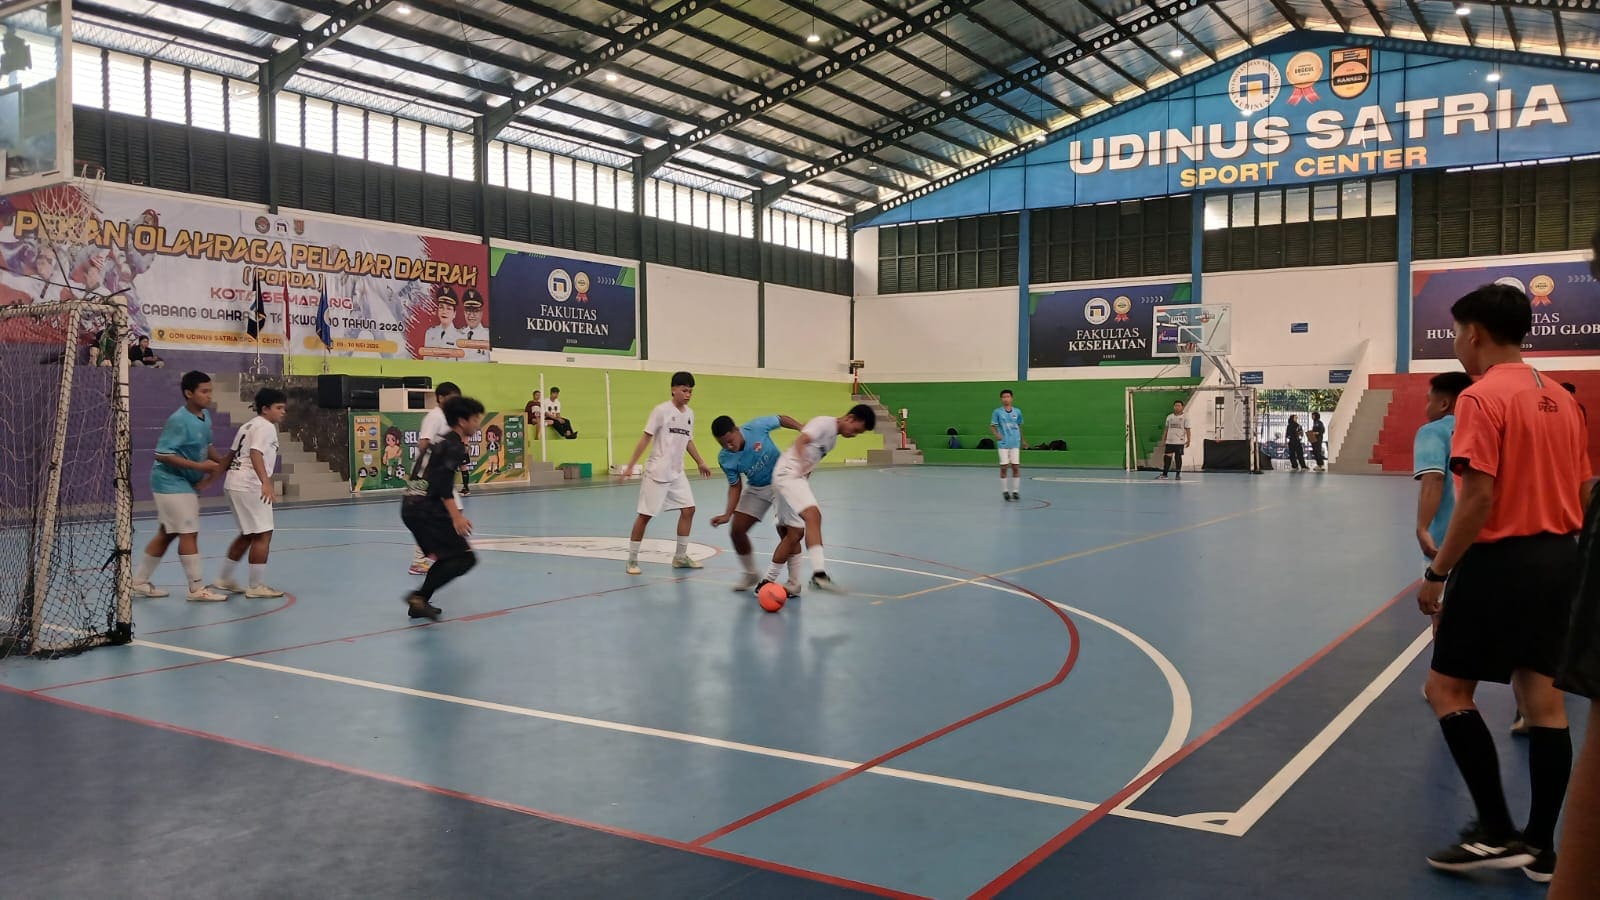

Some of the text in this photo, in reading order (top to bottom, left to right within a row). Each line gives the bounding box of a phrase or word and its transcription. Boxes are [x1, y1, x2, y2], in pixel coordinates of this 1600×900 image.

[1069, 84, 1568, 174] UDINUS SATRIA
[1180, 146, 1428, 188] SPORT CENTER
[133, 224, 288, 268] OLAHRAGA
[290, 243, 392, 280] PELAJAR
[394, 256, 478, 287] DAERAH
[262, 290, 353, 310] SEMARNG
[142, 303, 197, 319] CABANG
[342, 318, 377, 330] TAHUN
[379, 322, 404, 332] 2026
[540, 304, 597, 321] FAKULTAS
[526, 317, 609, 336] KEDOKTERAN
[1076, 327, 1140, 340] FAKULTAS
[1068, 338, 1147, 351] KESEHATAN
